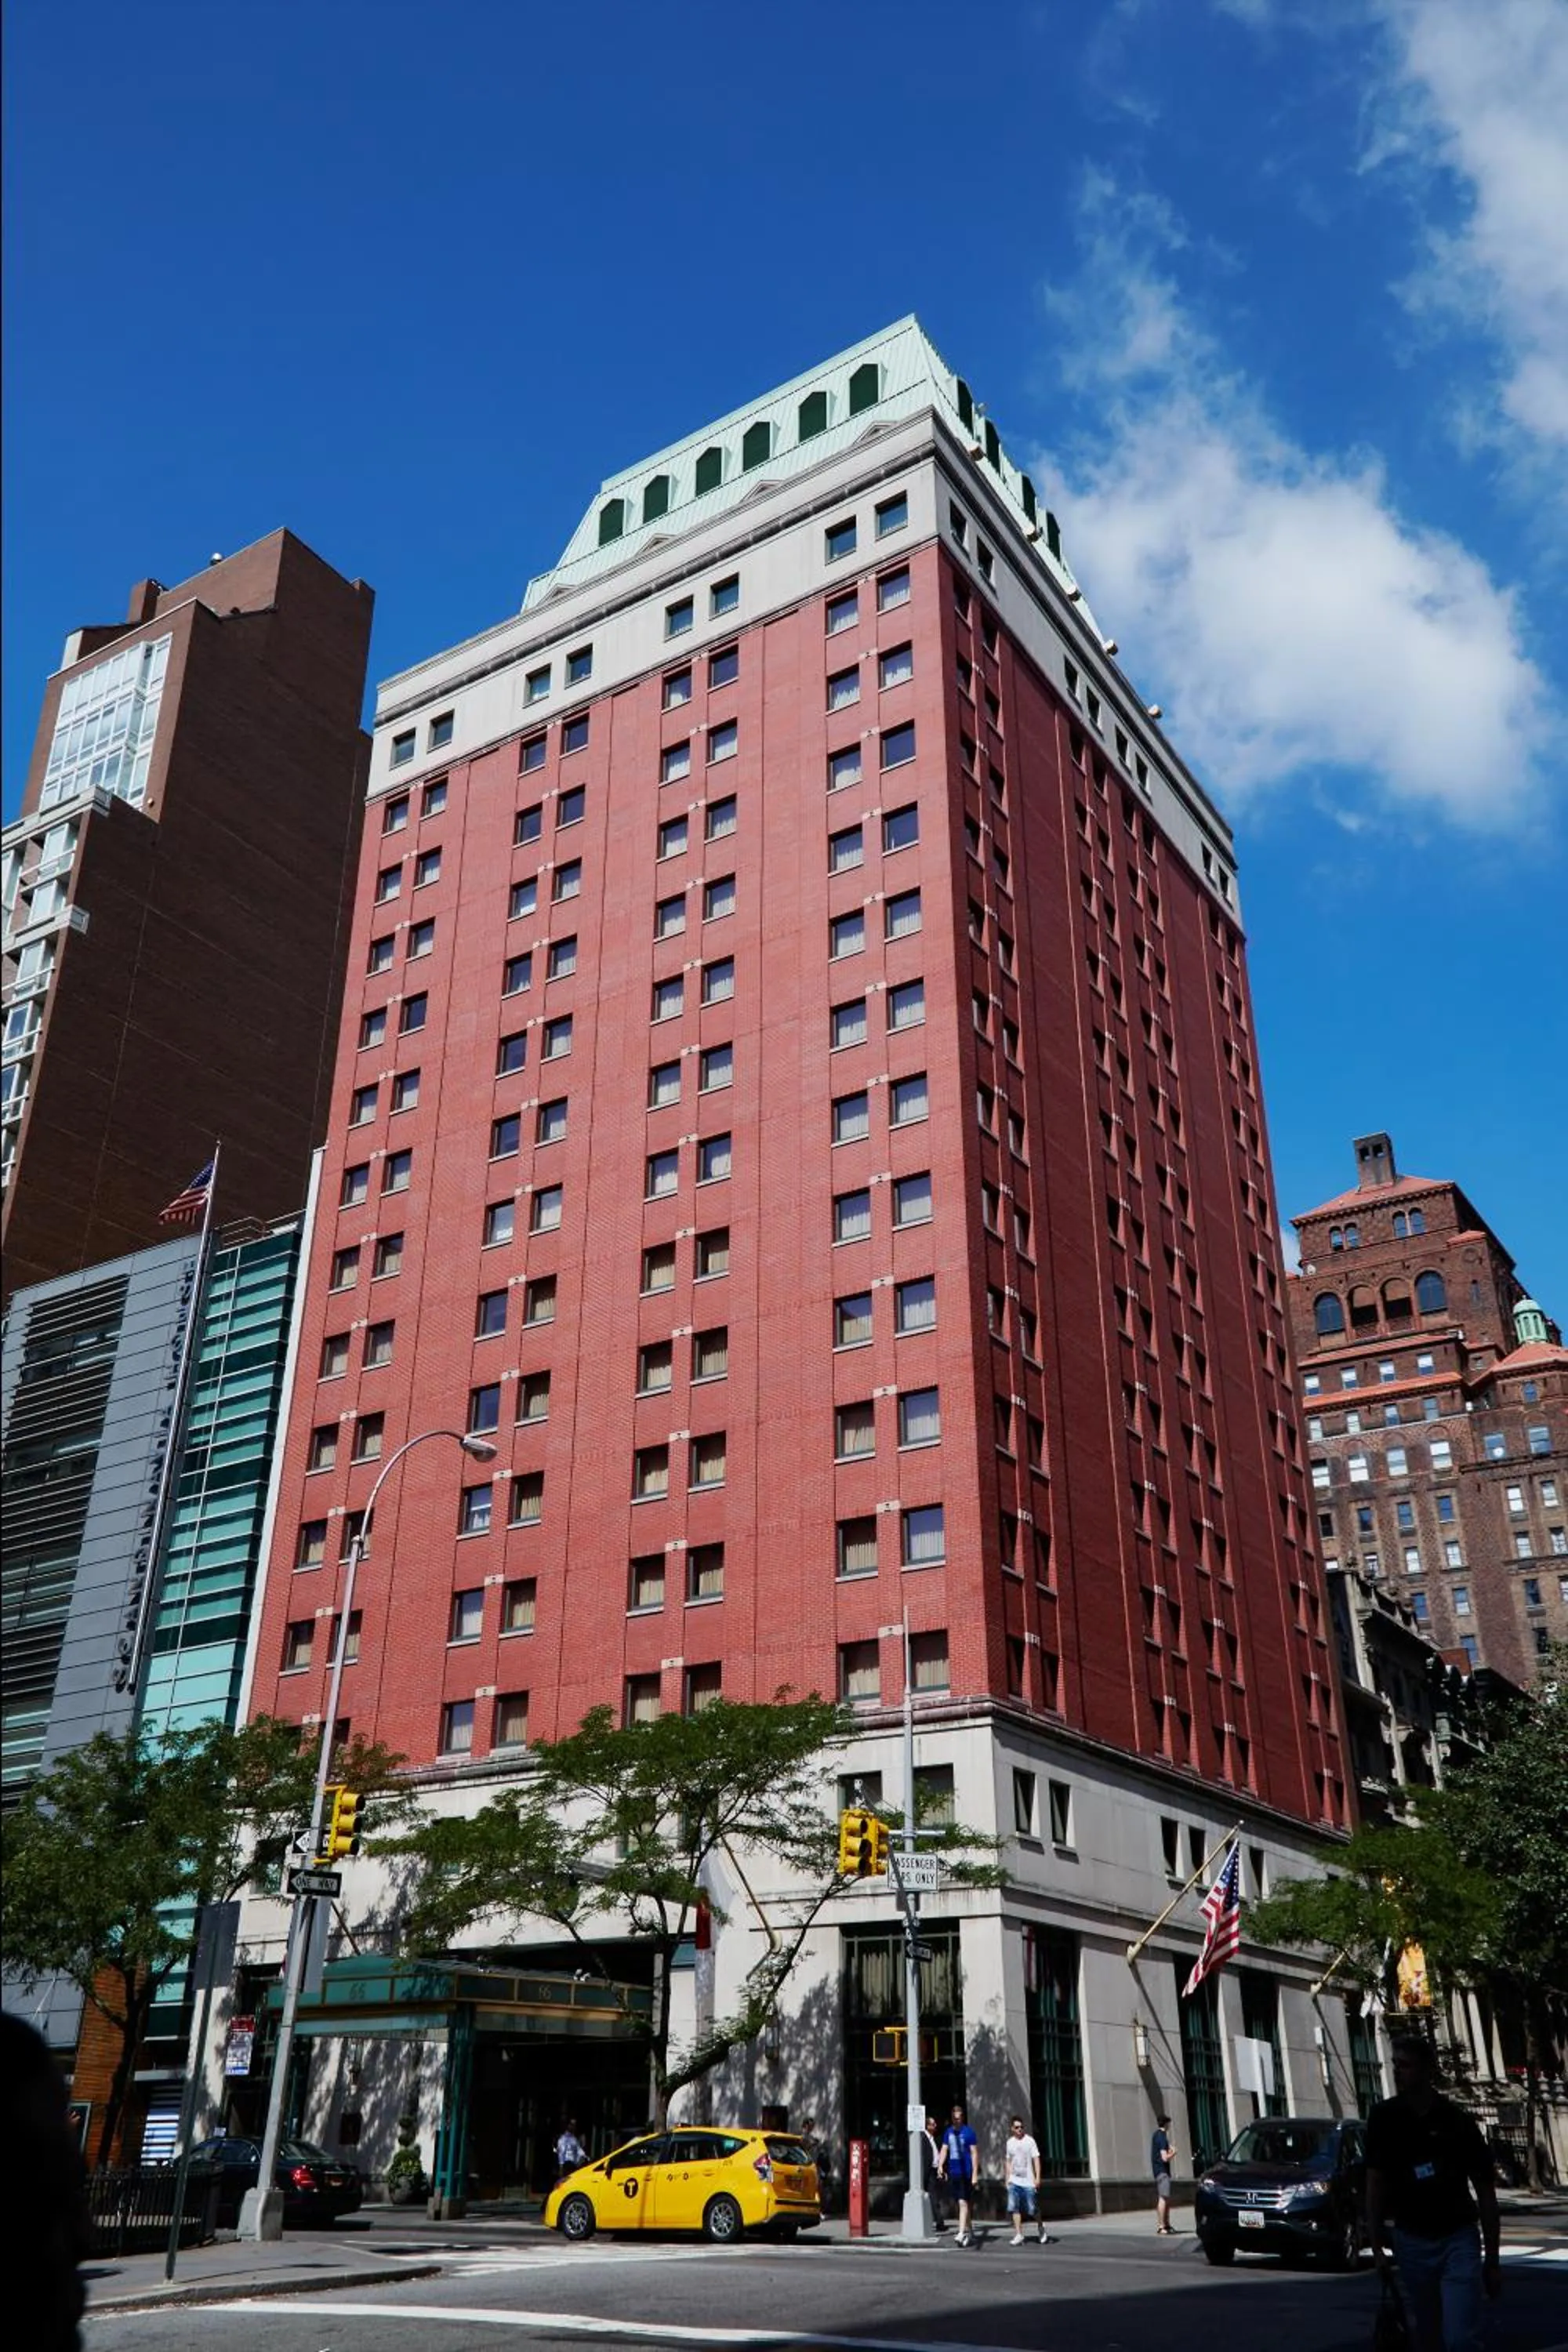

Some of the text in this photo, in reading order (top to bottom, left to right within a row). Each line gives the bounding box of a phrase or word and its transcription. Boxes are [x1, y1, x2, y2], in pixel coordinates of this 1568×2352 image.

[891, 1857, 935, 1869] ASSENGER
[296, 1875, 335, 1889] ONE WAY
[891, 1871, 935, 1884] CRS ONLY
